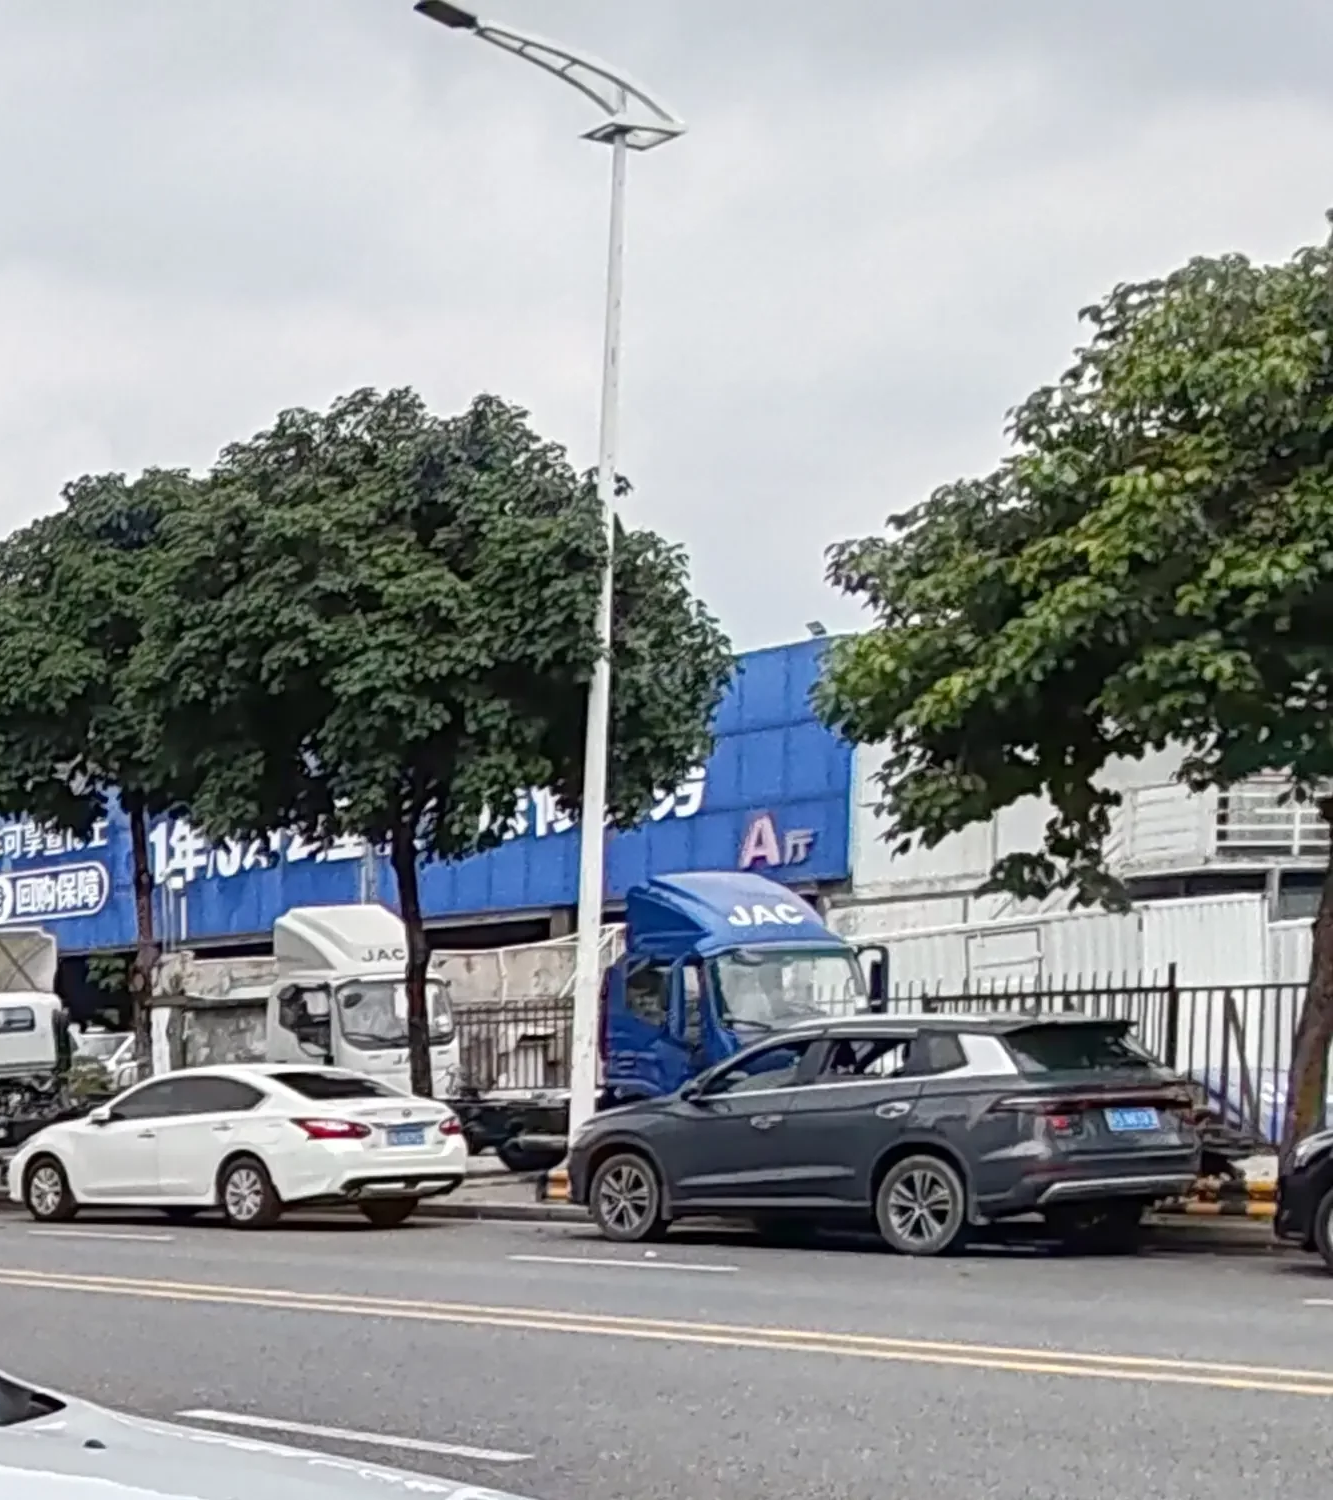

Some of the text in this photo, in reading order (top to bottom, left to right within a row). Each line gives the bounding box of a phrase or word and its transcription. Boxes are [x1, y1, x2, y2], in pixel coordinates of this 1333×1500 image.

[16, 870, 101, 915] 回购保障
[728, 903, 806, 926] JAC
[361, 948, 406, 963] JAC
